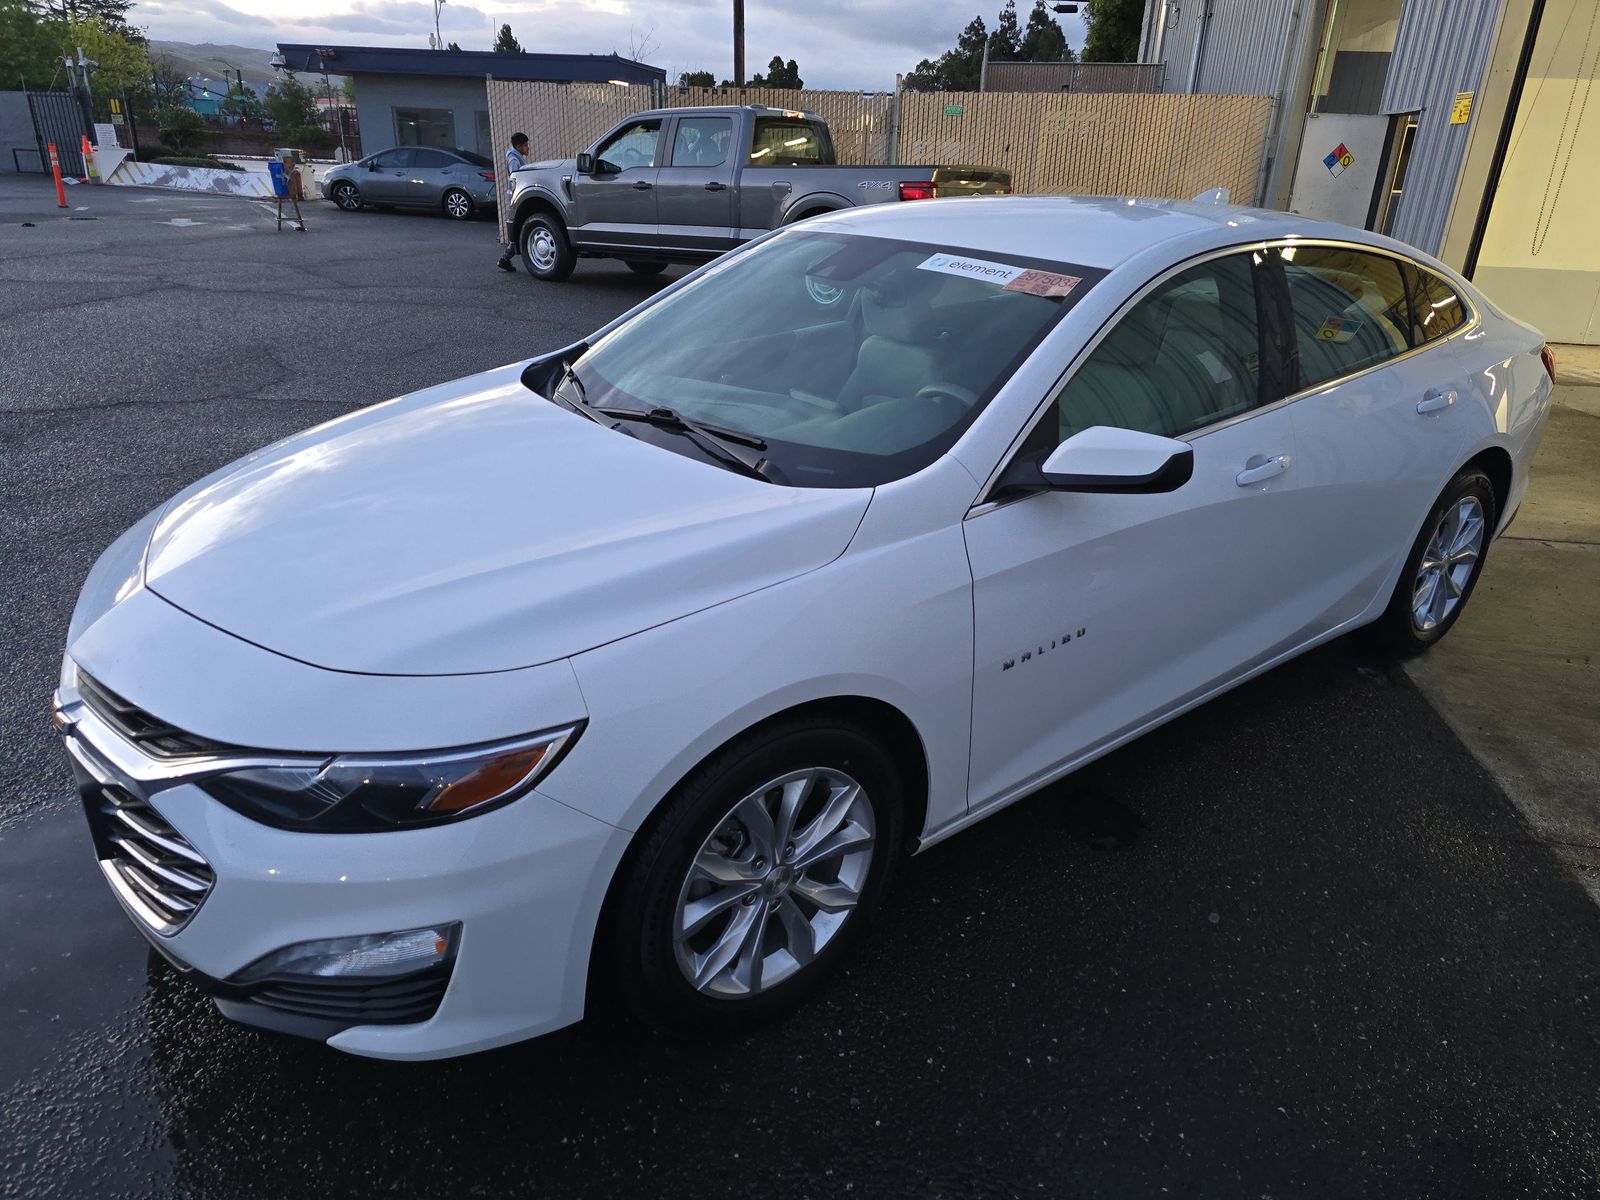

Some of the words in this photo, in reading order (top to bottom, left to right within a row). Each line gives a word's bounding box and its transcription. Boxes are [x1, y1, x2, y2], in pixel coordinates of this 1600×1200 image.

[1327, 154, 1337, 167] 2
[1342, 155, 1351, 167] 0
[949, 261, 1013, 278] element
[1002, 628, 1086, 671] MALIBU
